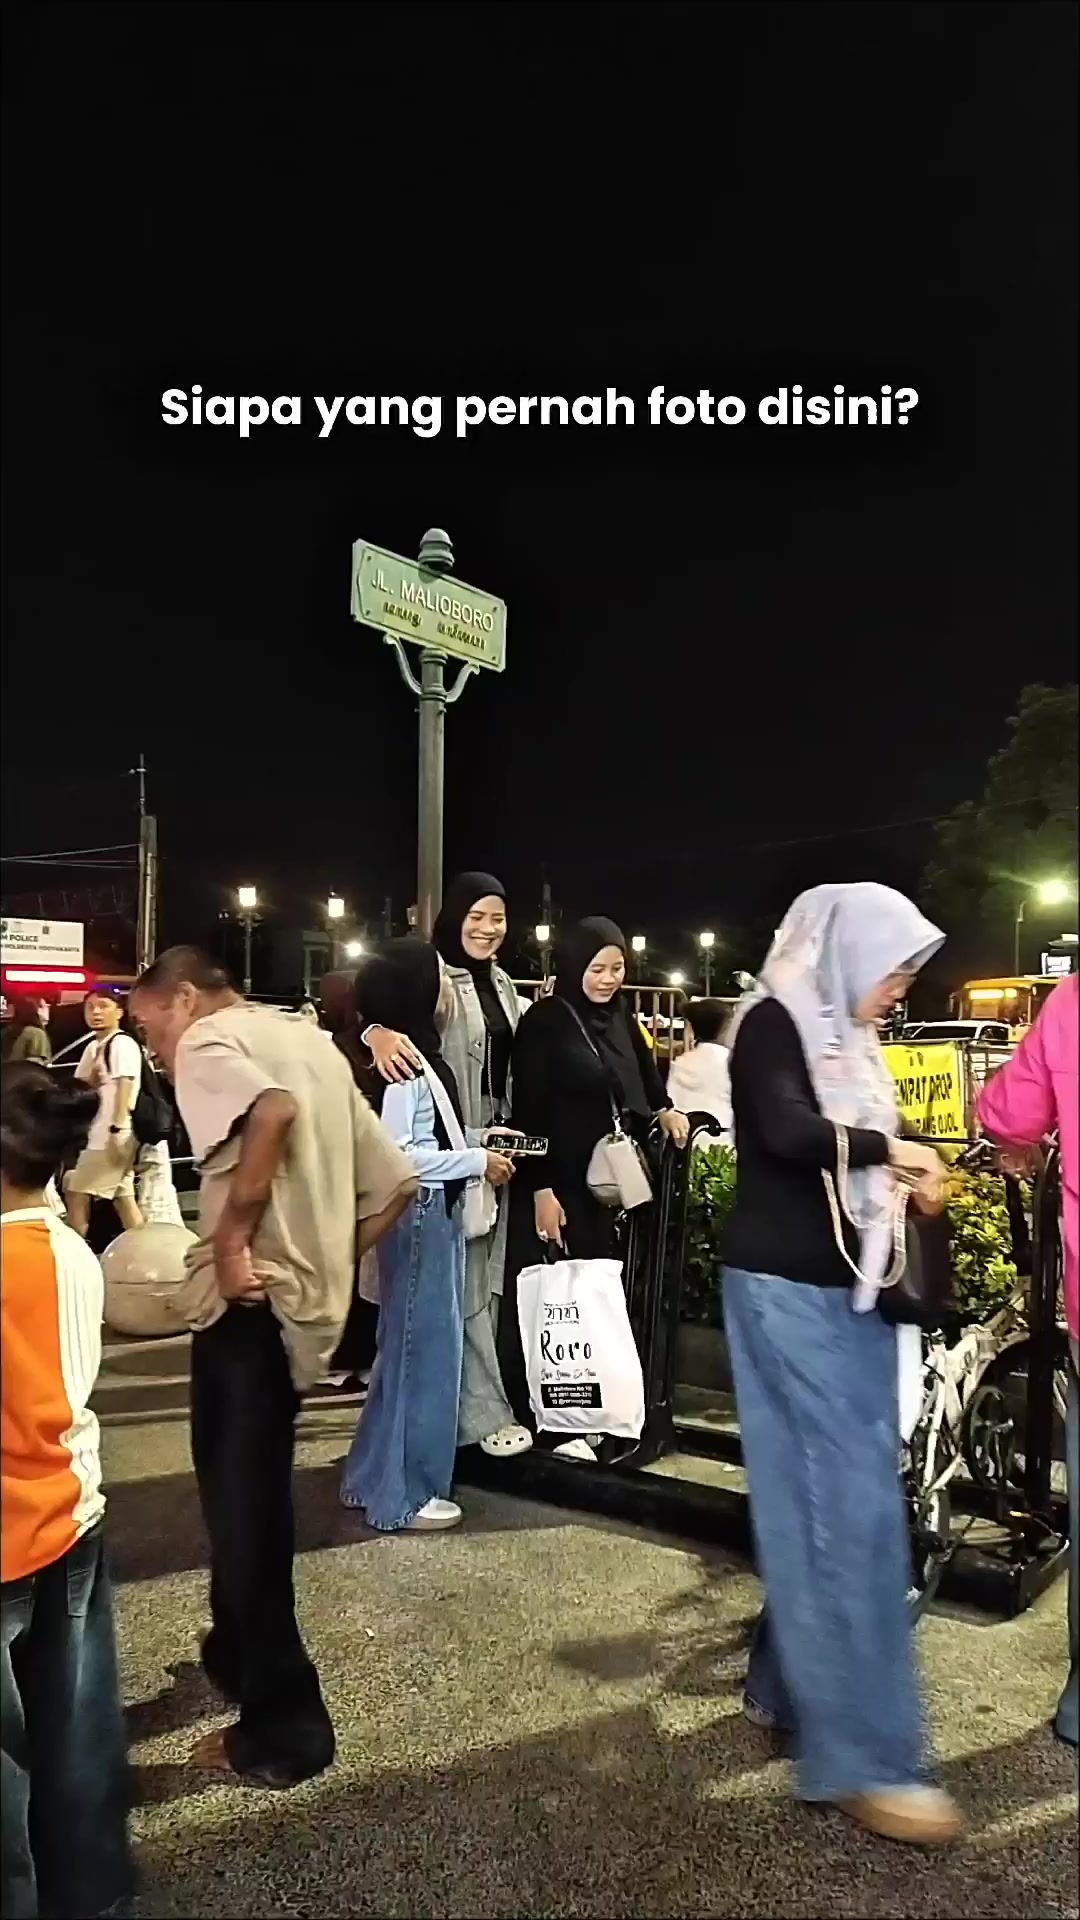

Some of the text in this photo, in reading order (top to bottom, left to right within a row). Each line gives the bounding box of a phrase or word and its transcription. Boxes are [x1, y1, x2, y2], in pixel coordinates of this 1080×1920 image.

[372, 567, 394, 595] JL.
[401, 579, 494, 632] MALIOBORO
[9, 934, 39, 943] POLICE
[928, 1072, 953, 1103] DROP
[540, 1329, 592, 1366] Roro
